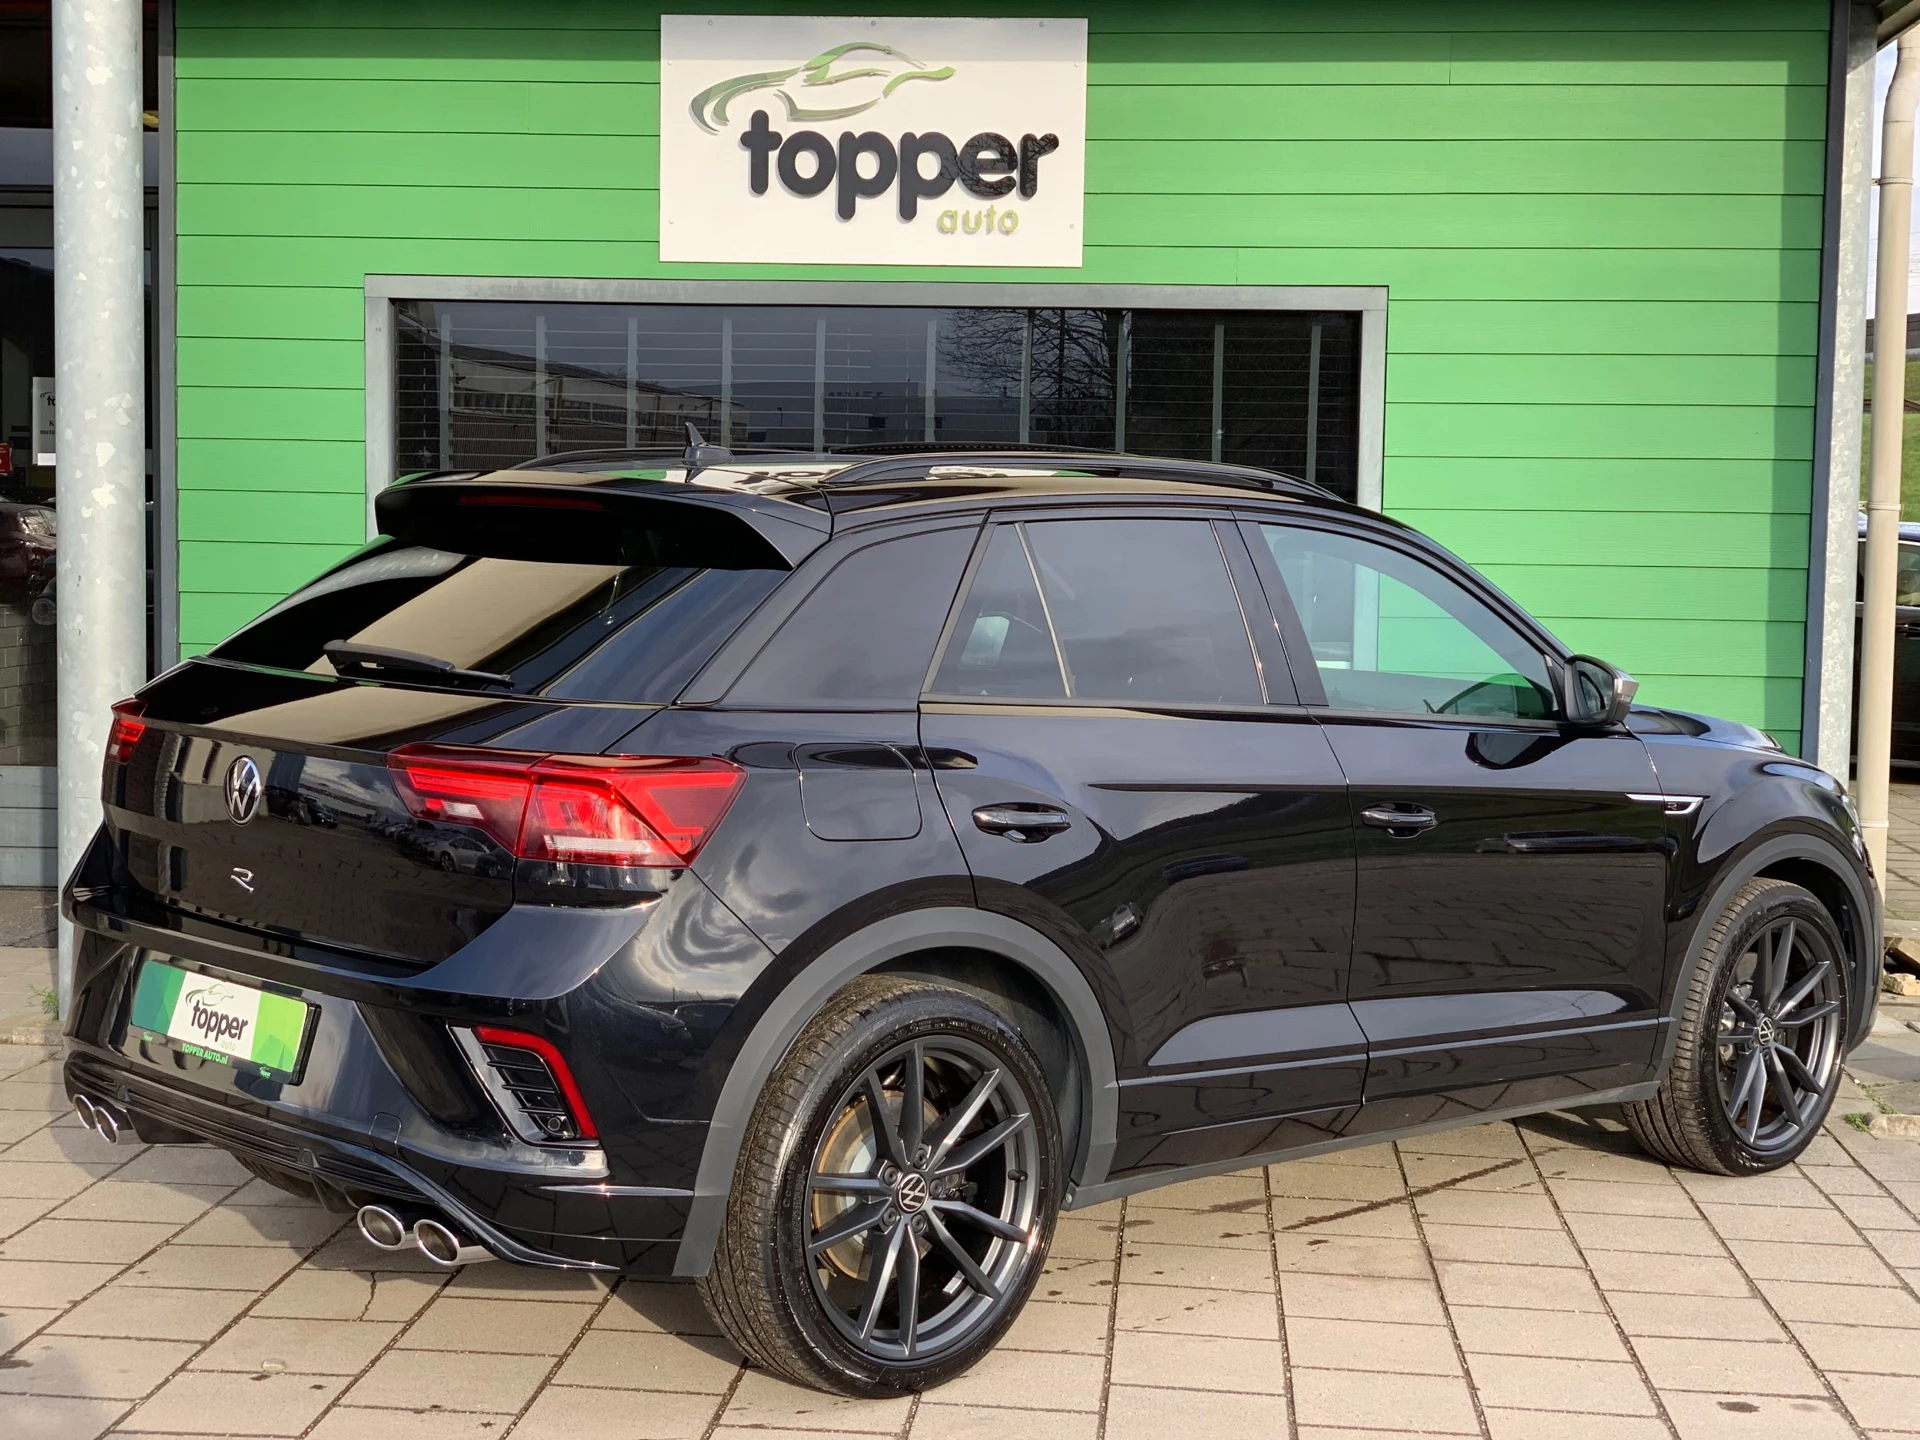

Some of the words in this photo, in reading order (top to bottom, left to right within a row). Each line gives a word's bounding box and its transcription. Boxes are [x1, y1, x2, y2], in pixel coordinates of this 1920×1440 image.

[741, 109, 1060, 220] topper
[938, 204, 1019, 234] auto
[191, 999, 249, 1043] topper
[181, 1043, 204, 1058] TOPPER
[203, 1050, 229, 1065] AUTO.nl
[220, 1040, 237, 1052] auto
